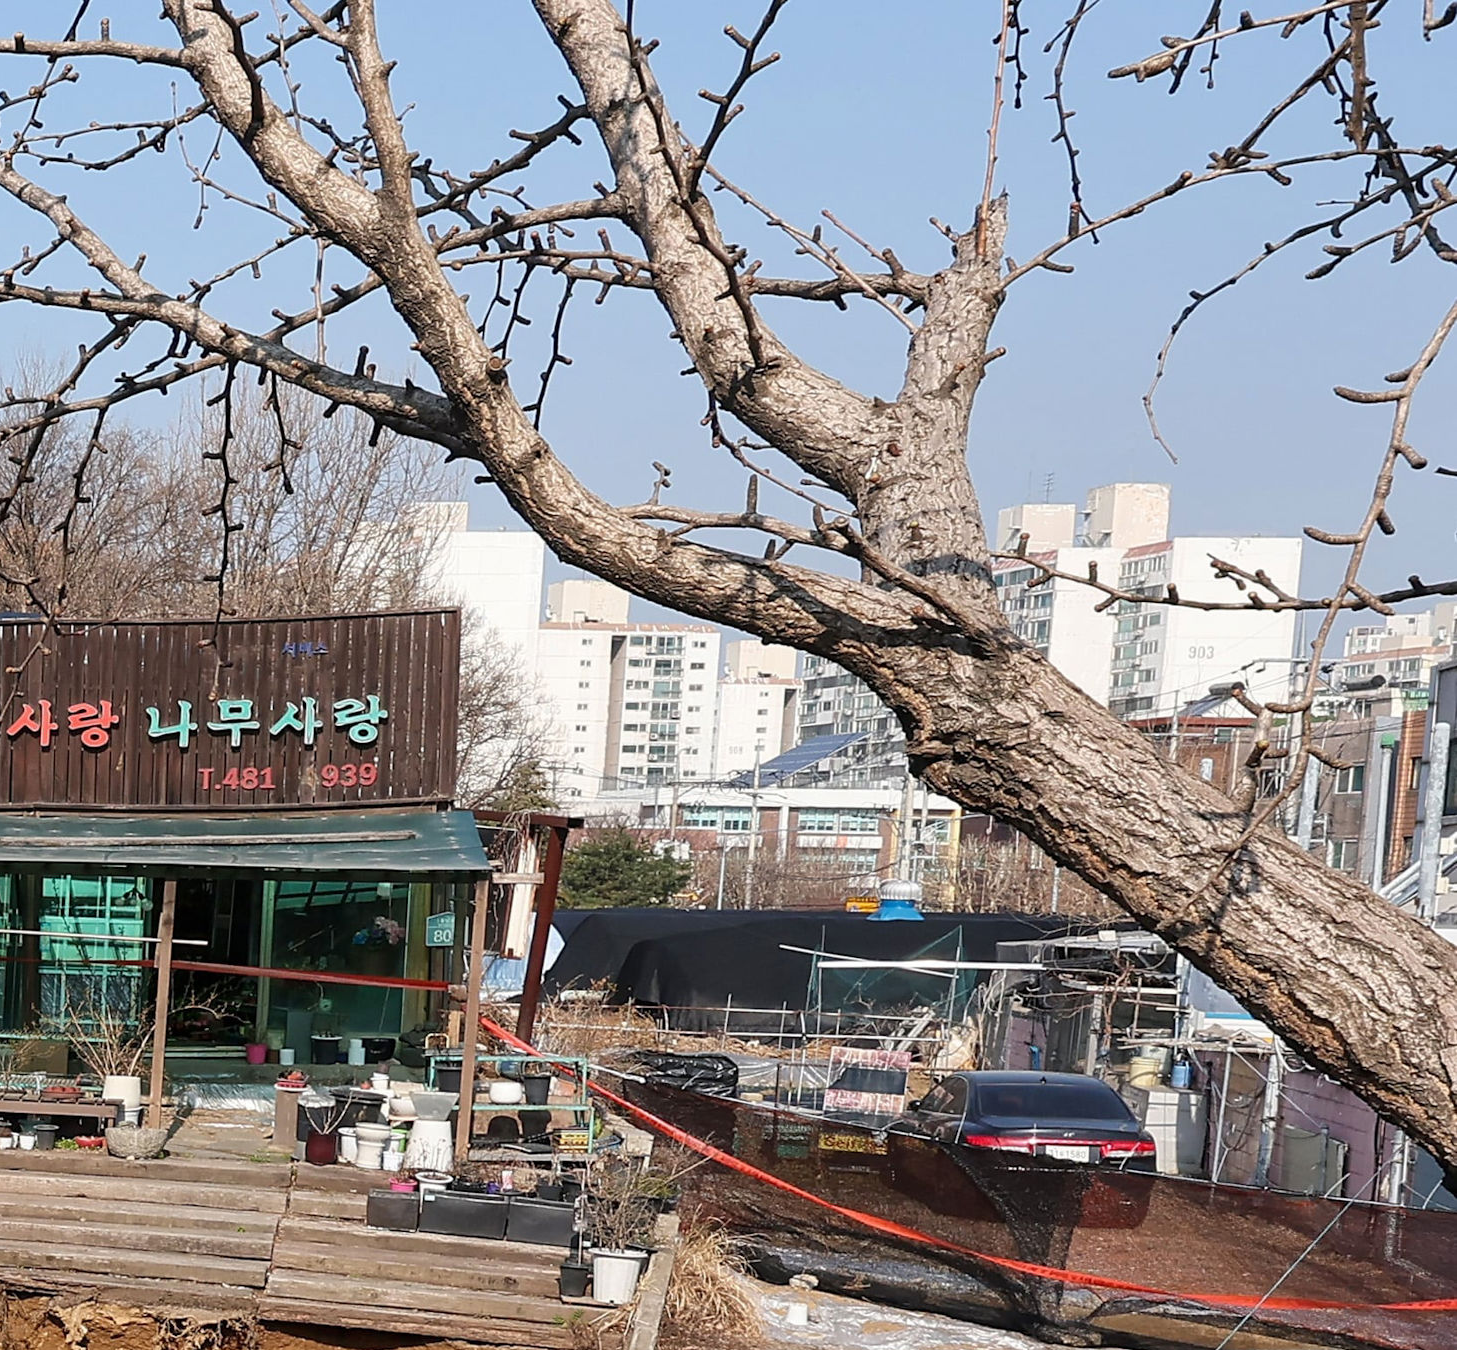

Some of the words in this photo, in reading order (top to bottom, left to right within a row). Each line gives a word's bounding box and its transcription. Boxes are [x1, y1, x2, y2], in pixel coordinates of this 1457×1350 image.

[1188, 646, 1214, 659] 903
[145, 693, 389, 749] 나무사랑
[320, 762, 379, 789] 939
[433, 929, 452, 943] 80
